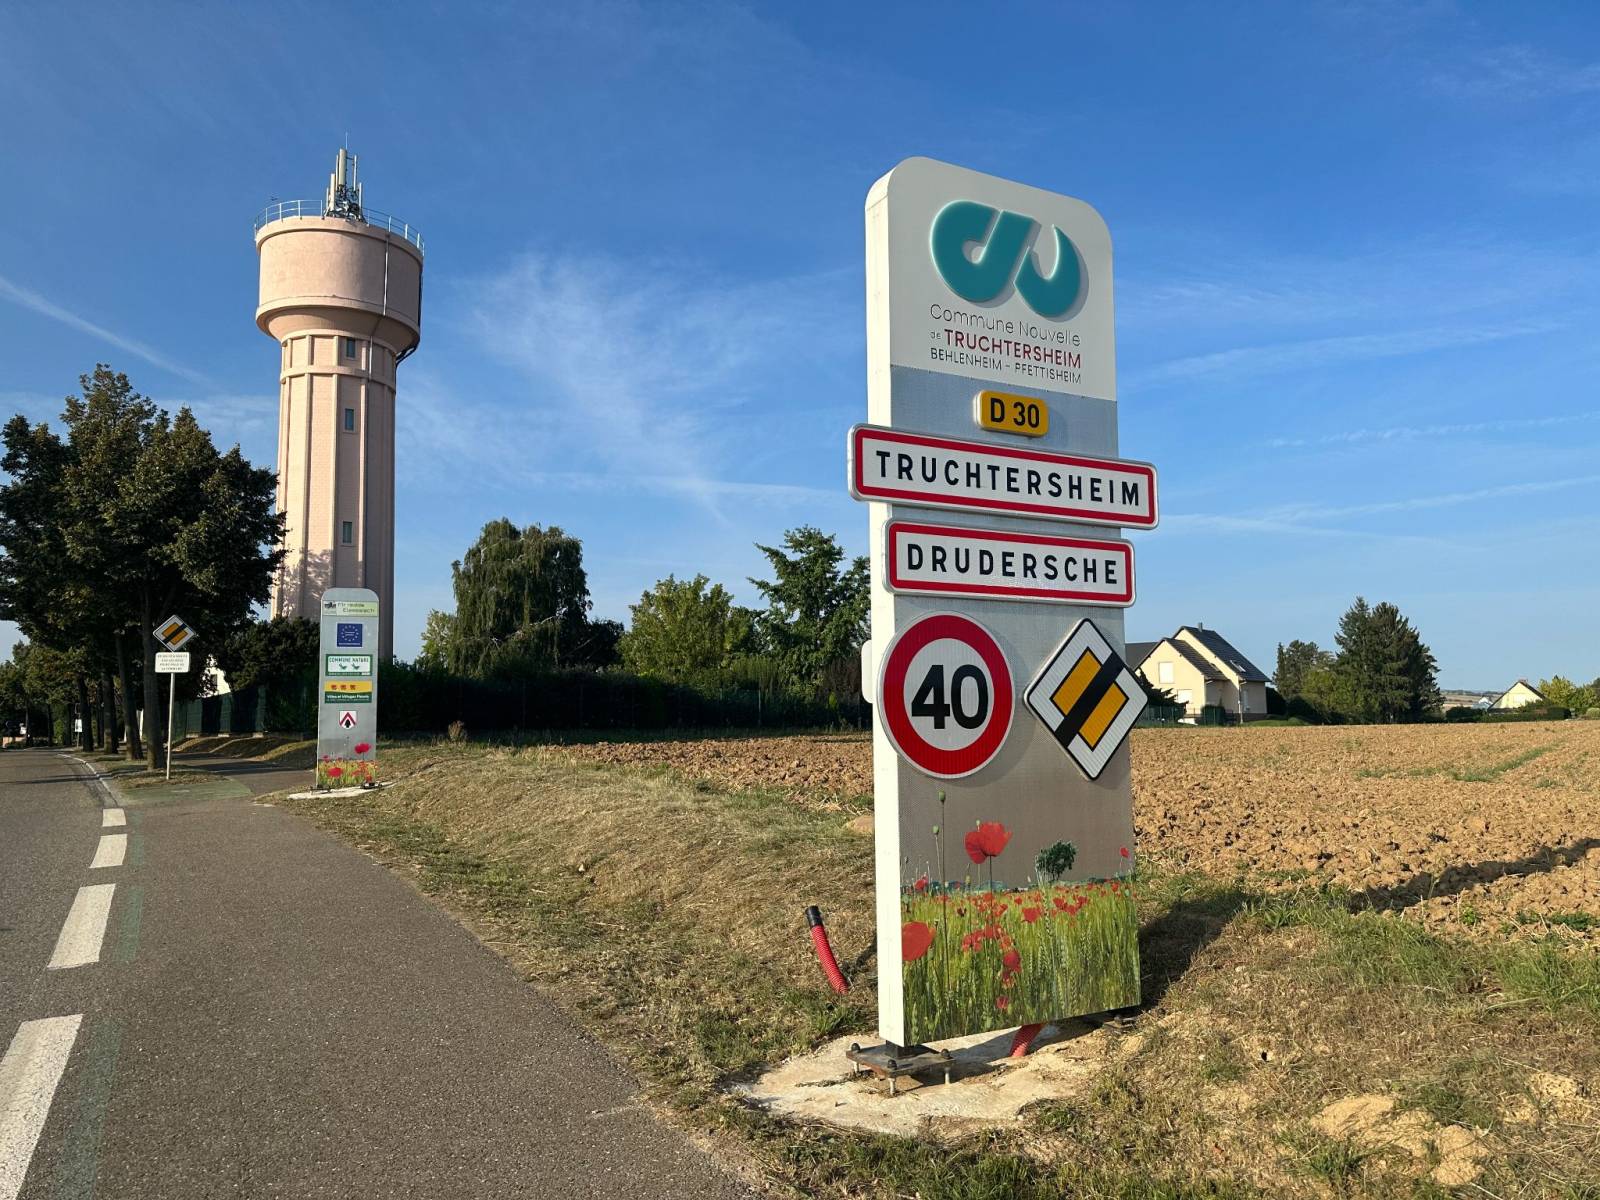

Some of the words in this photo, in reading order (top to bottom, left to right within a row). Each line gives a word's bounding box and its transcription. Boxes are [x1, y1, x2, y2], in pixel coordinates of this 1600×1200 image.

[930, 303, 1014, 334] Commune
[1019, 319, 1081, 347] Nouvelle
[930, 347, 1002, 371] BEHLENHEIM
[1015, 362, 1081, 384] PFETTISHEIM
[944, 328, 1081, 369] TRUCHTERSHEIM
[990, 396, 1005, 423] D
[1013, 401, 1040, 428] 30
[876, 450, 1139, 506] TRUCHTERSHEIM
[907, 543, 1118, 584] DRUDERSCHE
[911, 664, 989, 730] 40
